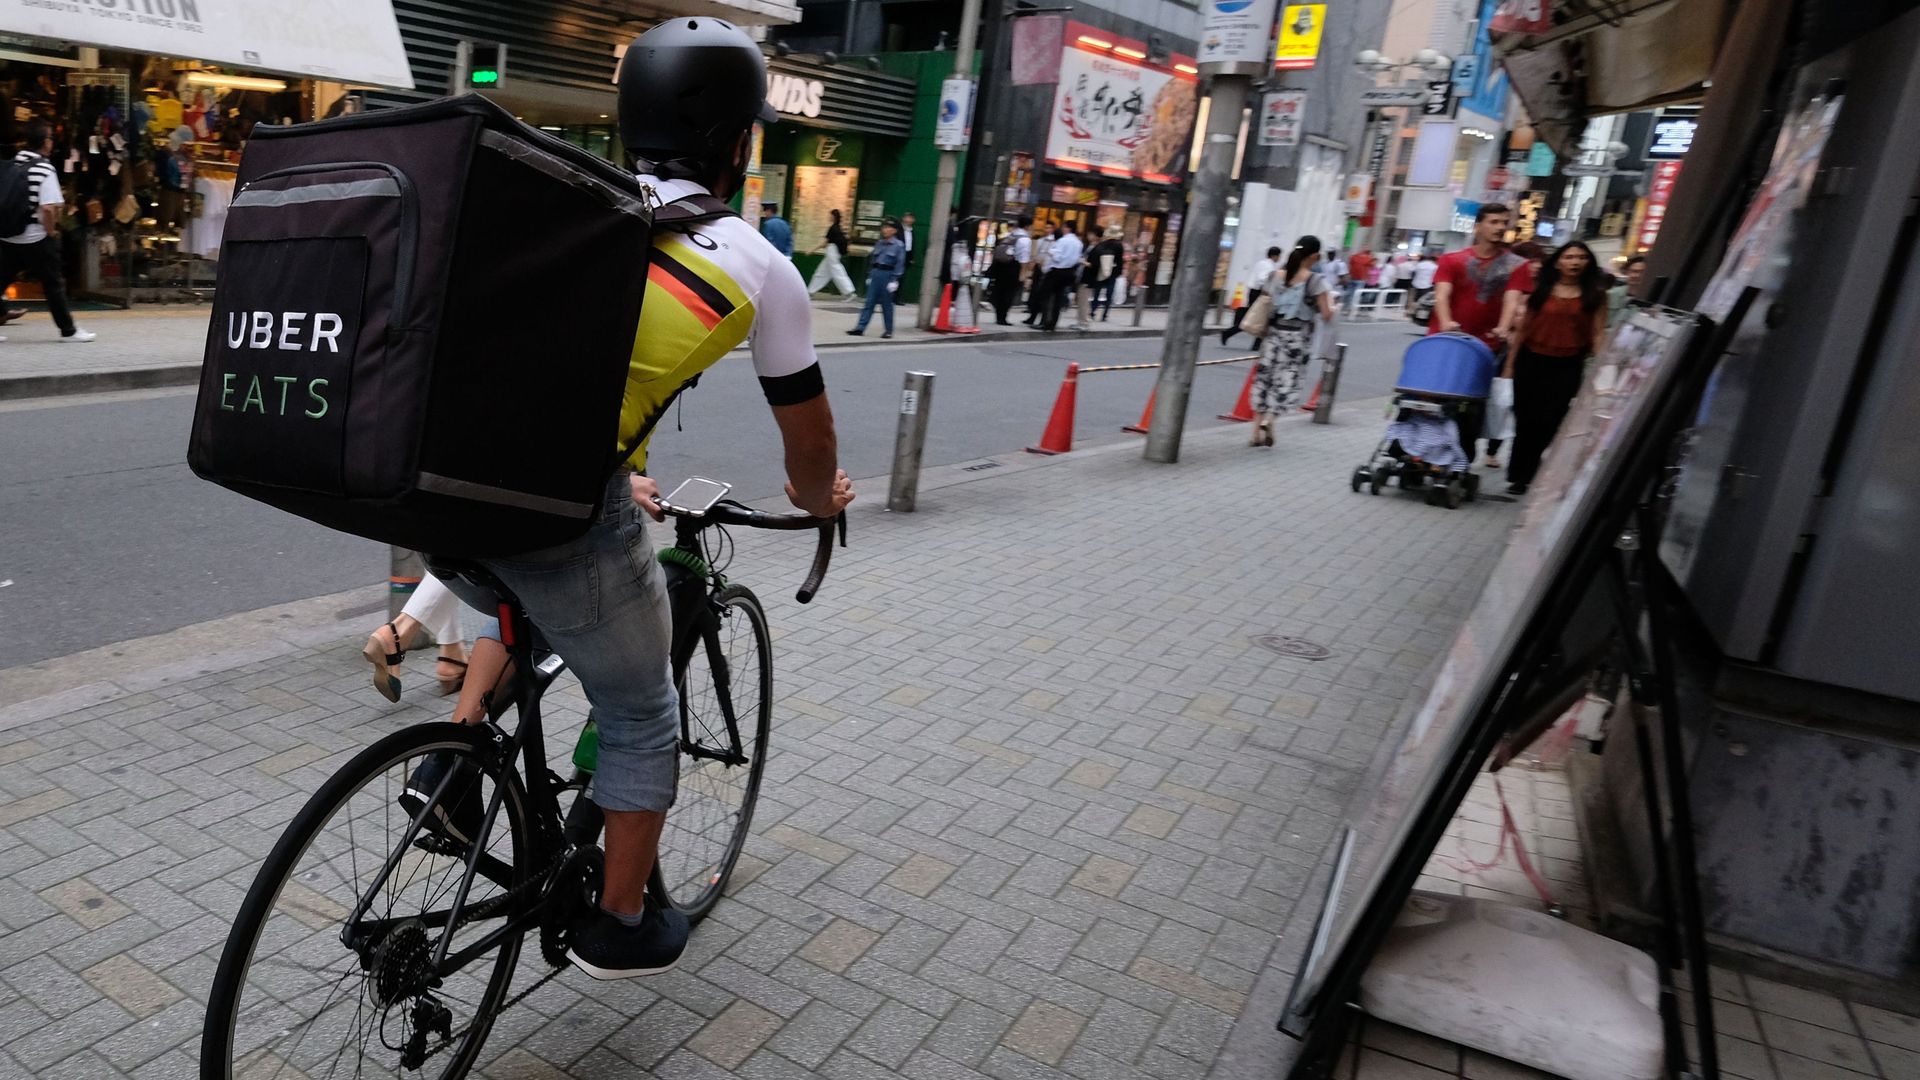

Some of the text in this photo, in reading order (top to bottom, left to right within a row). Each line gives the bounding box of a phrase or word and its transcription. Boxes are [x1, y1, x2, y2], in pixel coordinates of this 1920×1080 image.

[766, 73, 825, 118] NDS
[228, 311, 343, 353] UBER
[221, 373, 329, 419] EATS
